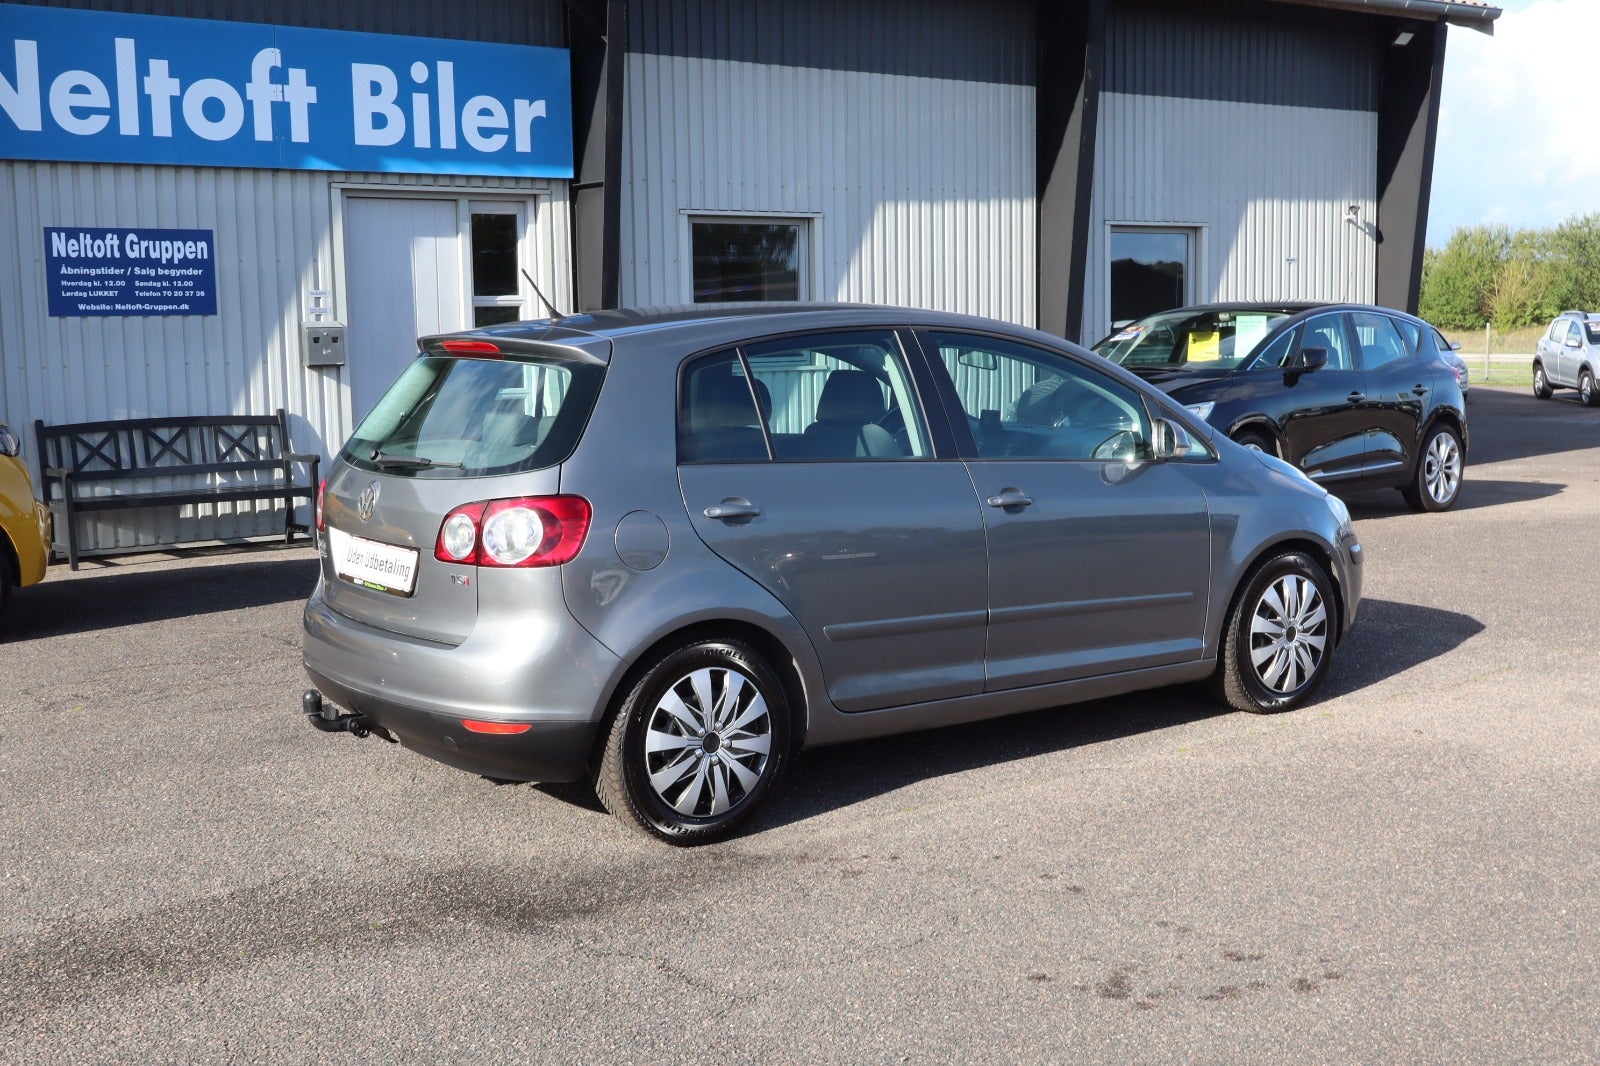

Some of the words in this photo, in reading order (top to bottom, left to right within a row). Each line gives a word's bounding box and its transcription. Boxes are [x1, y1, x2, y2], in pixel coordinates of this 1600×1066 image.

[0, 37, 317, 143] Neltoft
[351, 60, 546, 153] Biler
[51, 232, 121, 258] Neltoft
[124, 233, 208, 264] Gruppen
[60, 264, 125, 276] Åbningstider
[127, 266, 132, 276] /
[134, 266, 155, 276] Salg
[157, 267, 203, 277] begynder
[61, 280, 92, 288] Hverdag
[135, 280, 161, 288] Søndag
[61, 290, 87, 298] Lørdag
[78, 303, 114, 311] Website:
[115, 303, 190, 312] Neltoft-Gruppen.dk
[347, 546, 364, 565] Uden
[365, 551, 410, 582] Udbetaling
